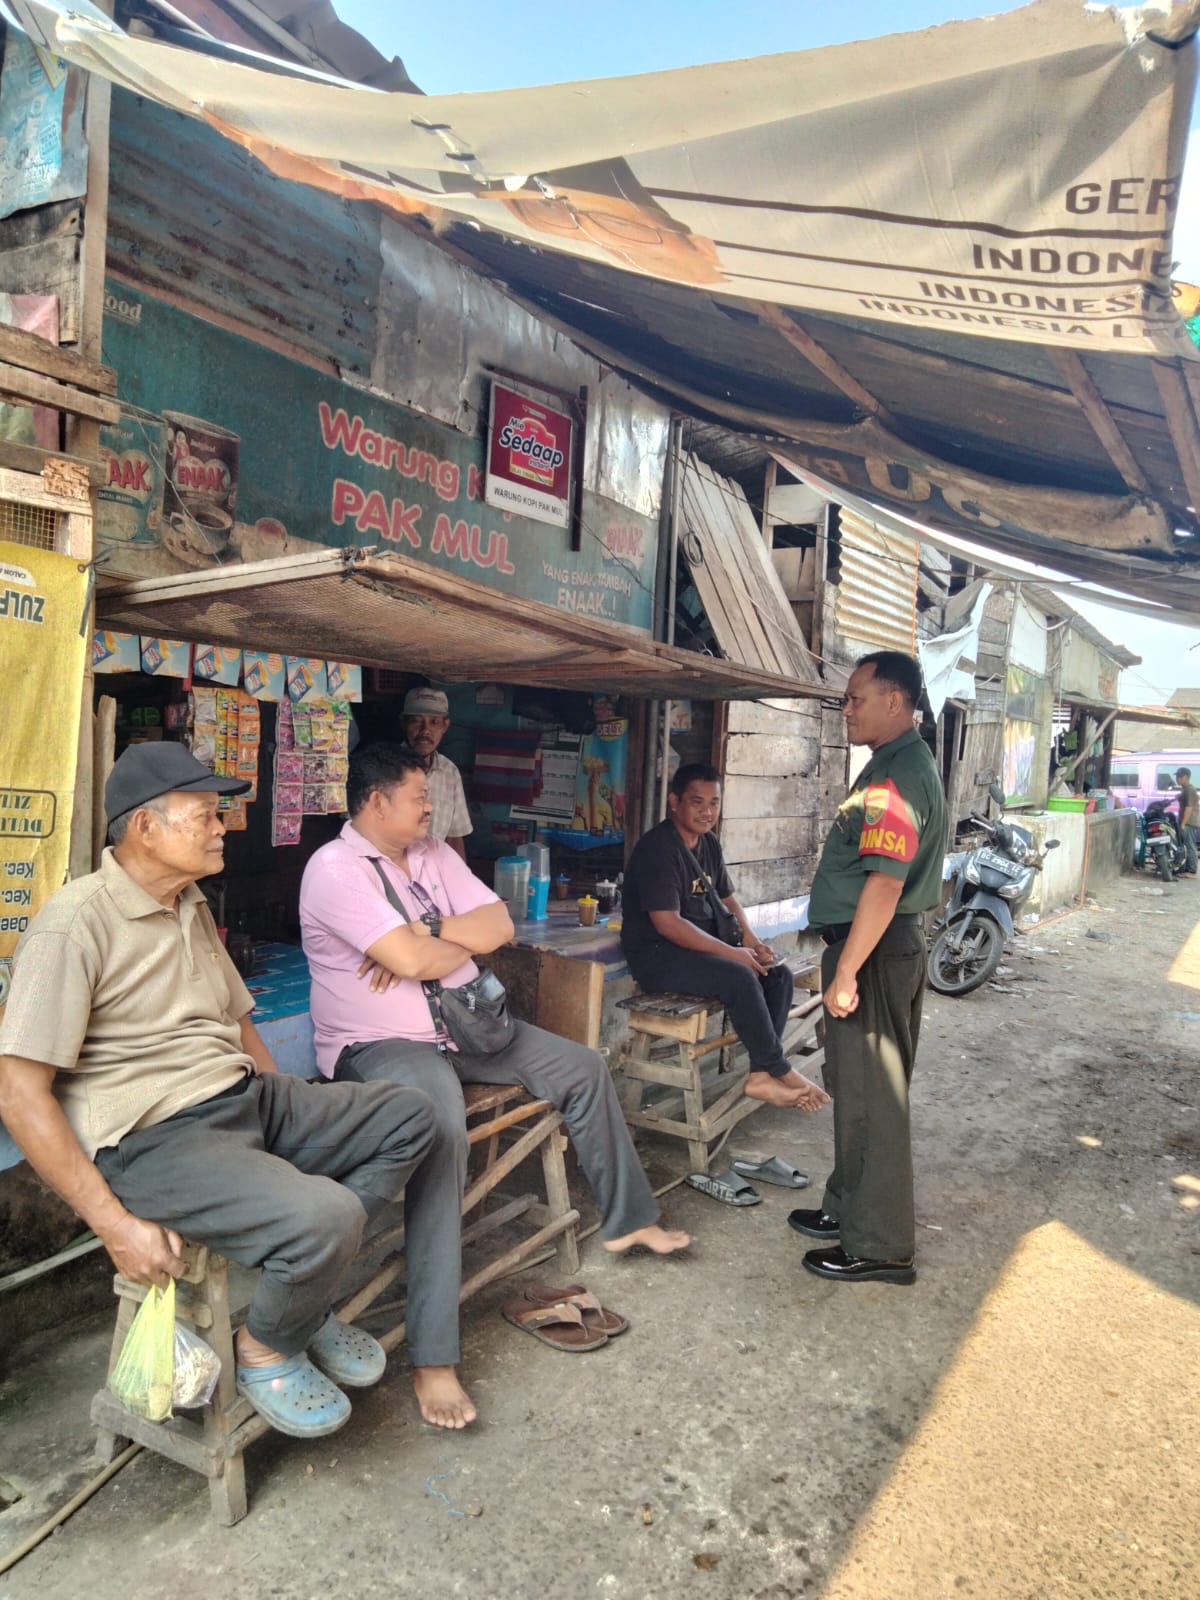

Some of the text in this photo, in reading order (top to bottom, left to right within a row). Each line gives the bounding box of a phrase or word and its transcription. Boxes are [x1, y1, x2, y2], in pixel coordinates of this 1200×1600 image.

[1065, 177, 1181, 215] GER
[858, 298, 1094, 336] INDONESIA
[510, 417, 525, 432] Mie
[318, 401, 460, 501] Warung
[500, 425, 563, 468] Sedaap
[177, 465, 228, 492] ENAAK
[494, 487, 563, 516] WARUNG KOPI PAK MUL
[332, 478, 422, 548] PAK
[431, 514, 515, 575] MUL
[4, 568, 26, 579] CALON
[543, 560, 569, 584] YANG
[572, 571, 594, 586] ENAK
[4, 862, 35, 878] Kec.
[1, 889, 31, 905] Kec.
